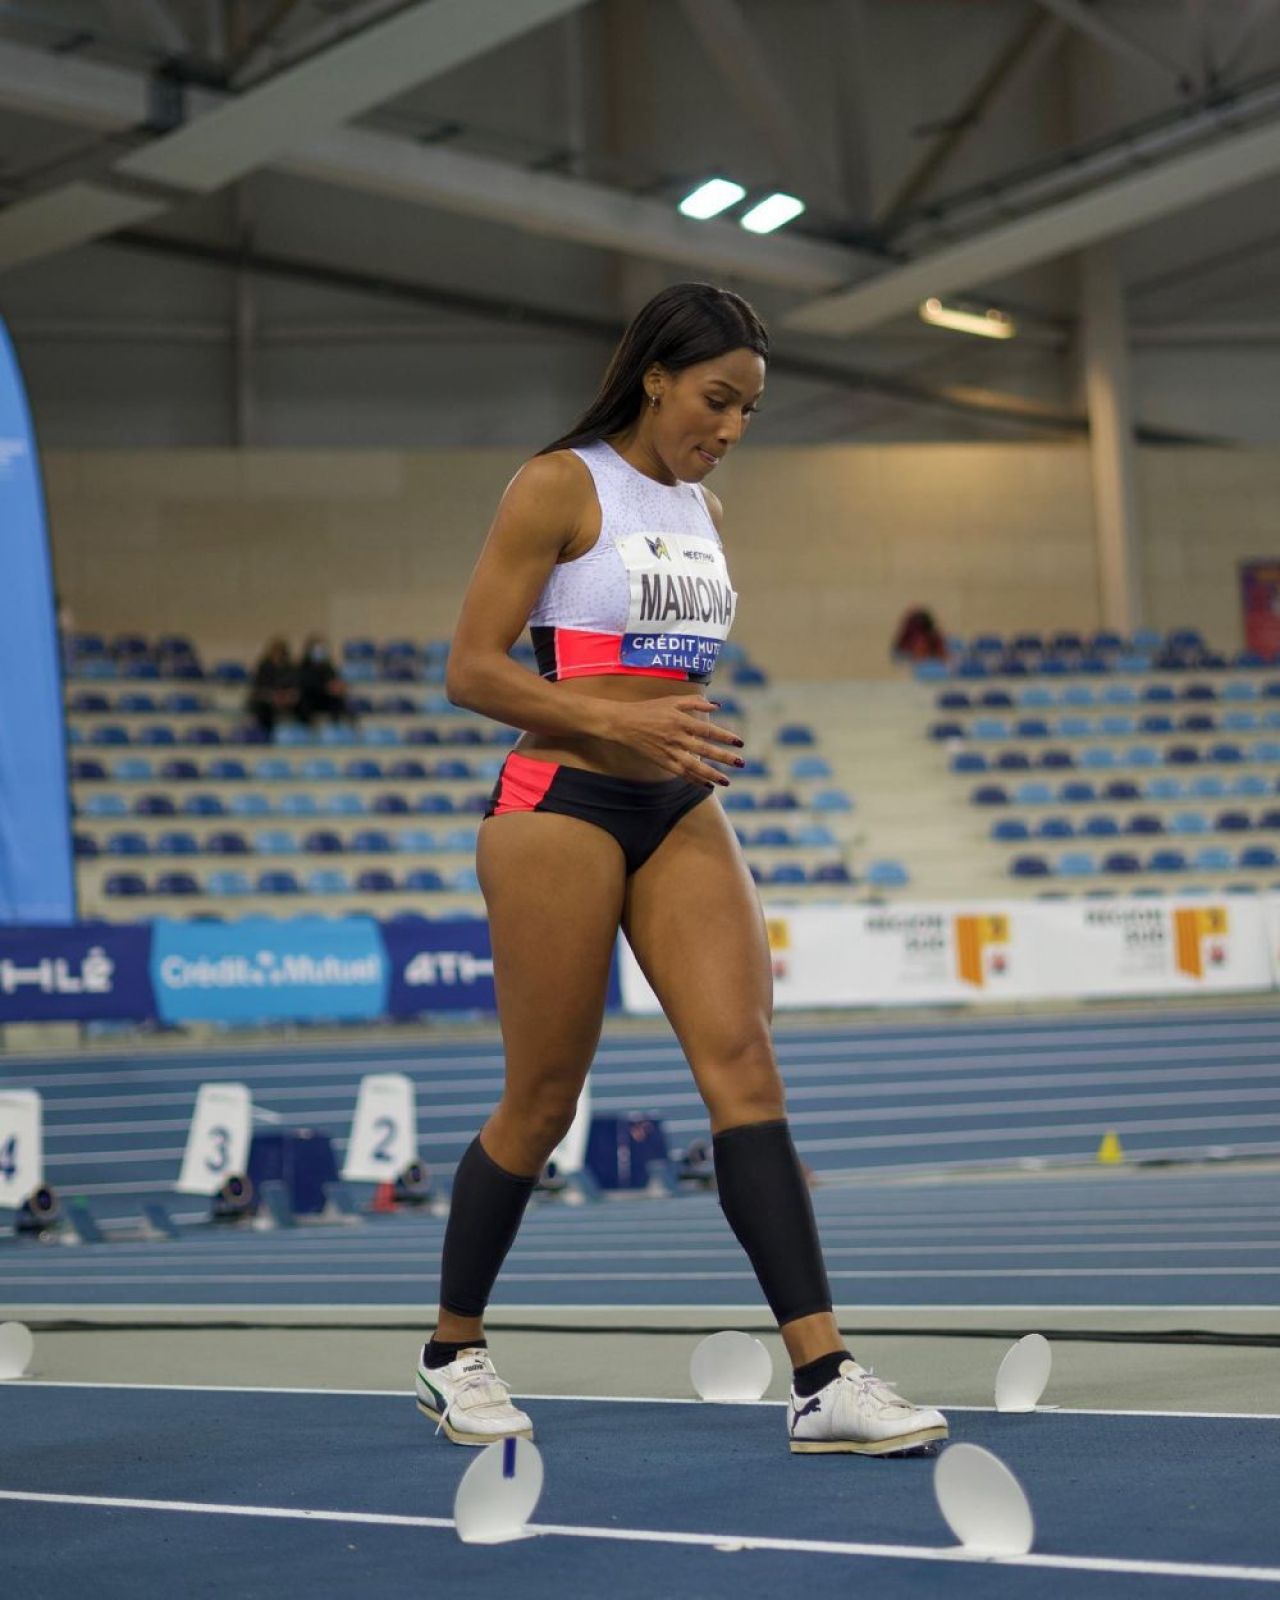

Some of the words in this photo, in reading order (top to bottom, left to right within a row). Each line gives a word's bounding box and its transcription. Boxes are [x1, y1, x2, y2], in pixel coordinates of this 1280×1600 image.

[639, 574, 732, 625] MAMONA
[632, 634, 696, 651] CRÉDIT
[698, 640, 721, 655] MUT
[652, 652, 700, 670] ATHLÉ
[0, 1134, 17, 1183] 4
[205, 1125, 230, 1172] 3
[371, 1117, 396, 1162] 2
